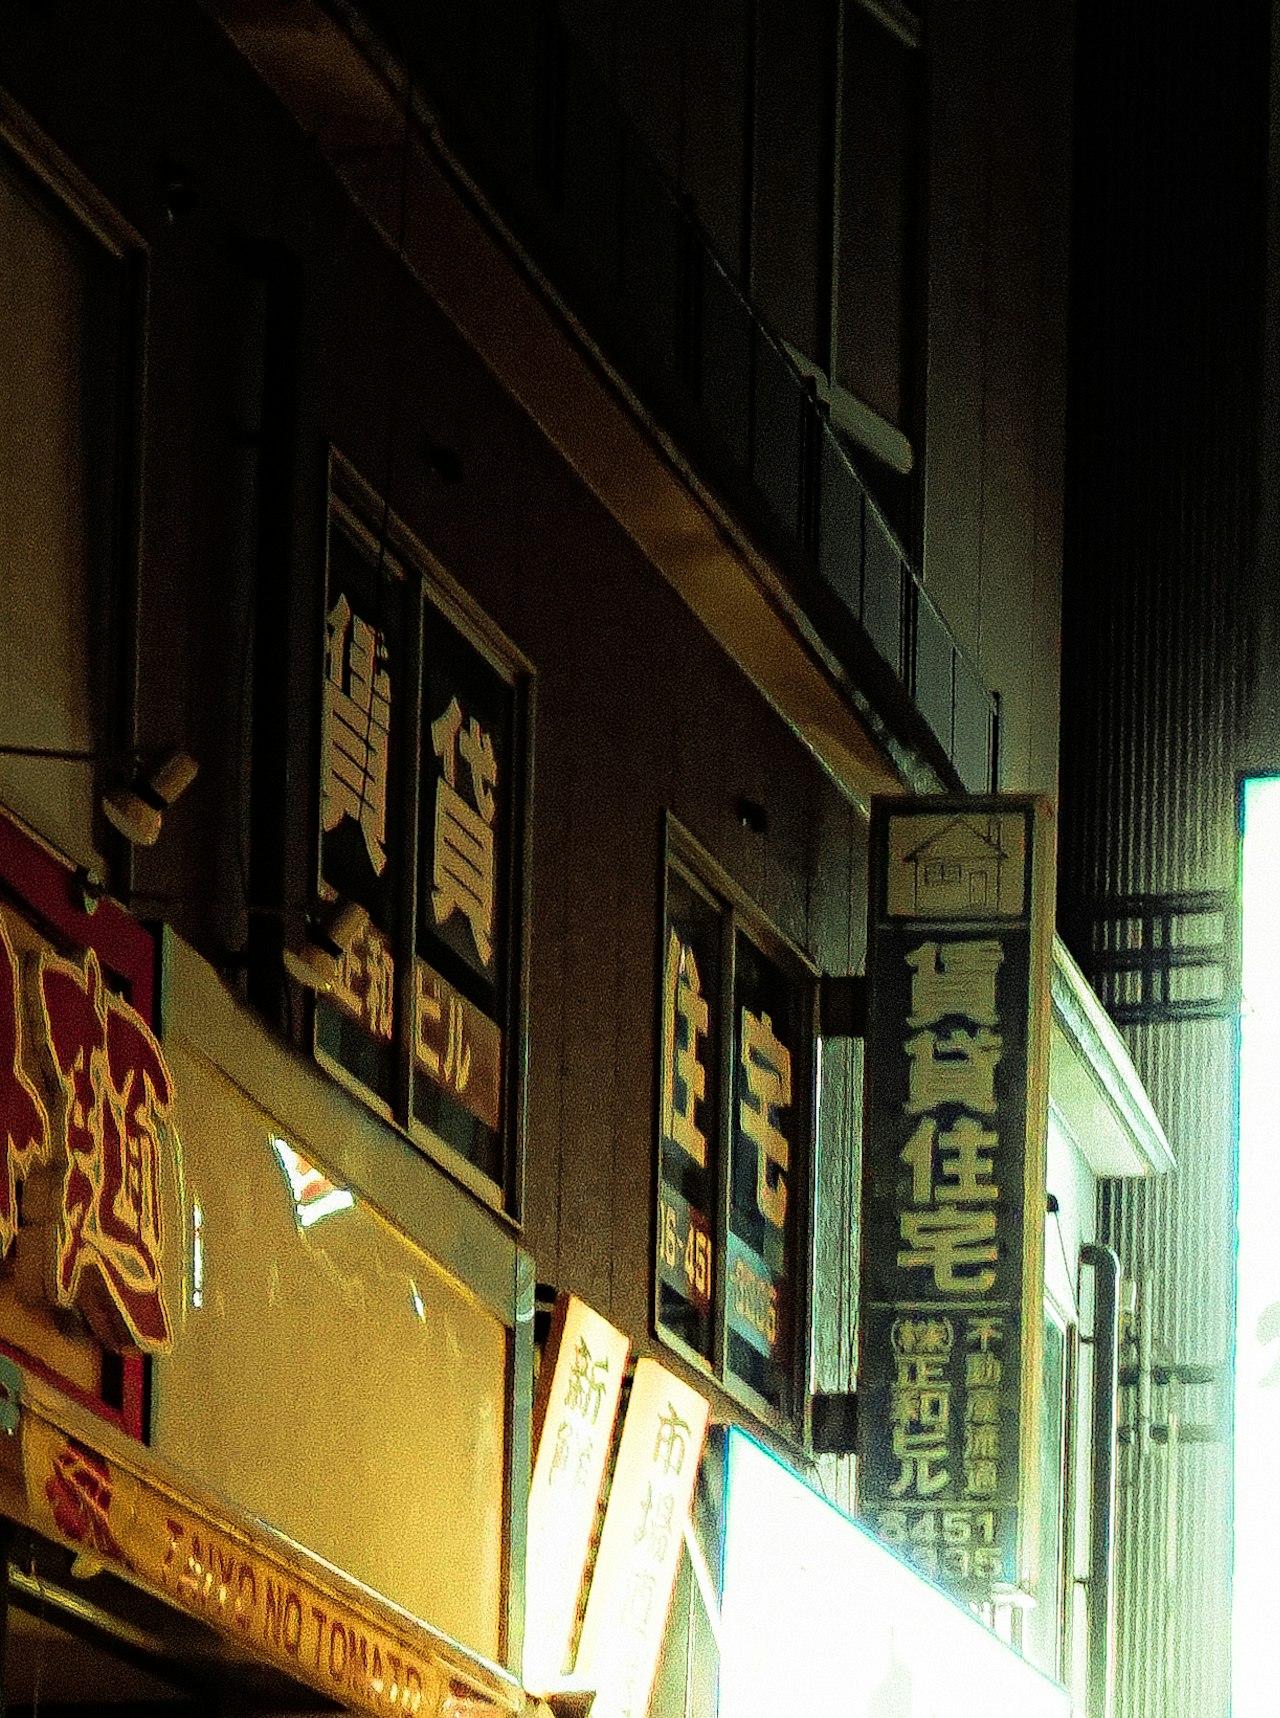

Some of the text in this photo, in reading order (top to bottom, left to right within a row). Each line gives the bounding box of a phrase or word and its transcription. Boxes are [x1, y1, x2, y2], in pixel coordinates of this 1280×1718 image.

[895, 938, 1005, 1294] 賃貸住宅
[161, 1517, 257, 1632] TAIYO
[263, 1577, 303, 1656] NO
